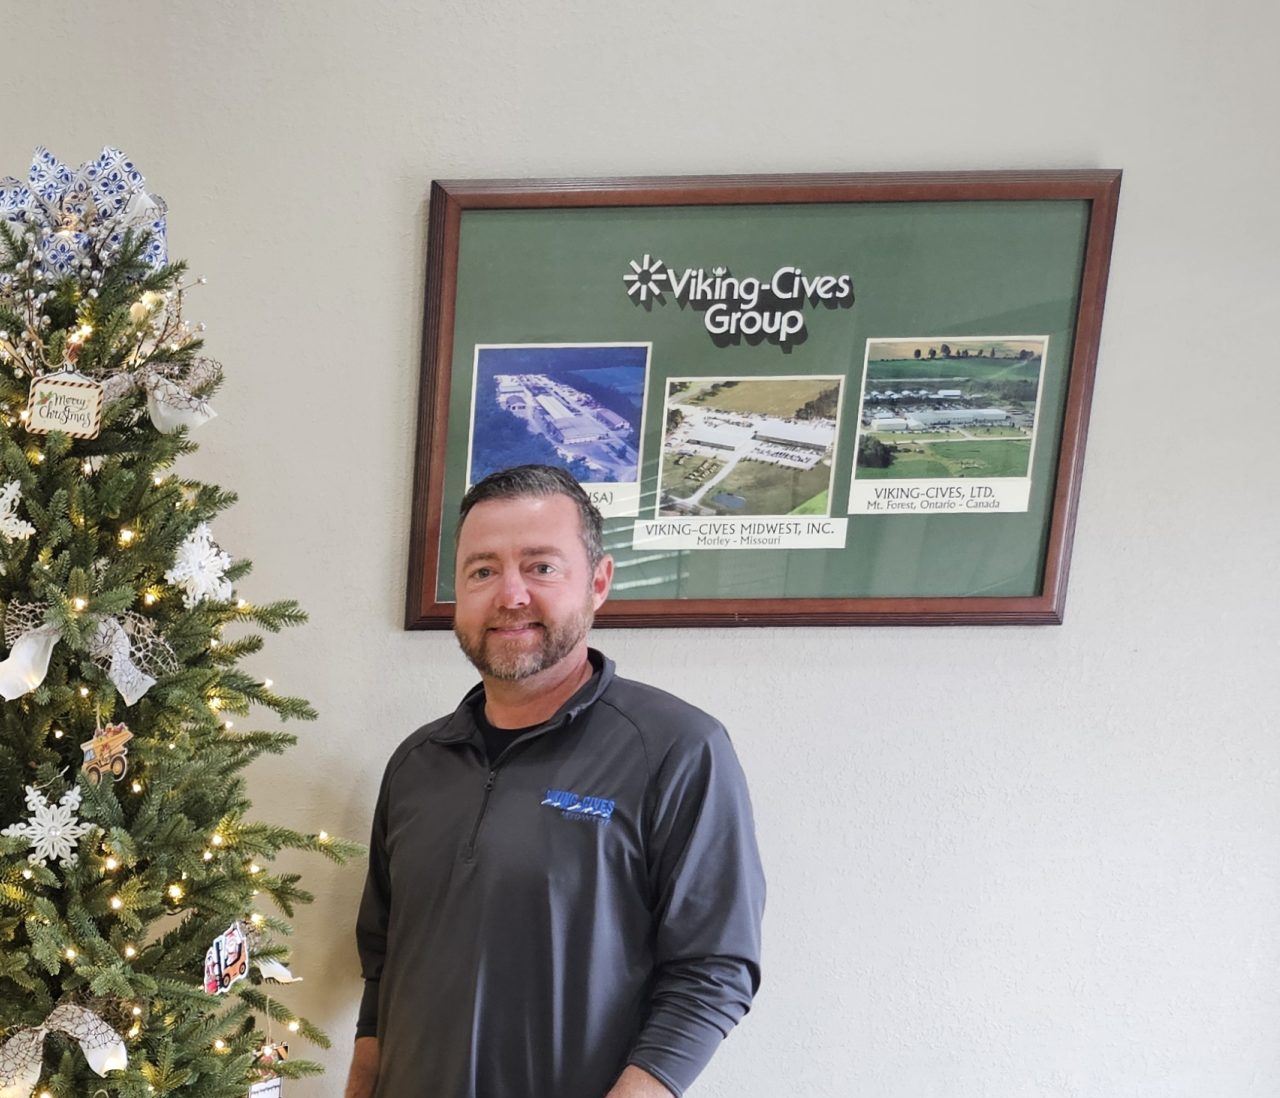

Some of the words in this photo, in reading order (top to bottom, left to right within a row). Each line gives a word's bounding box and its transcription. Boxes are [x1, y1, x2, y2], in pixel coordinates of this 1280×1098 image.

[667, 266, 850, 309] Viking-Cives
[704, 304, 803, 341] Group
[53, 393, 88, 412] Merry
[39, 401, 90, 428] Christmas
[874, 487, 965, 499] VIKING-CIVES,
[970, 487, 995, 499] LTD.
[867, 501, 883, 510] Mt.
[887, 500, 916, 511] Forest,
[920, 499, 955, 509] Ontario
[966, 499, 1000, 509] Canada
[645, 524, 735, 536] VIKING-CIVES
[740, 523, 801, 536] MIDWEST,
[807, 523, 835, 535] INC.
[696, 536, 729, 547] Morley
[740, 535, 781, 546] Missouri
